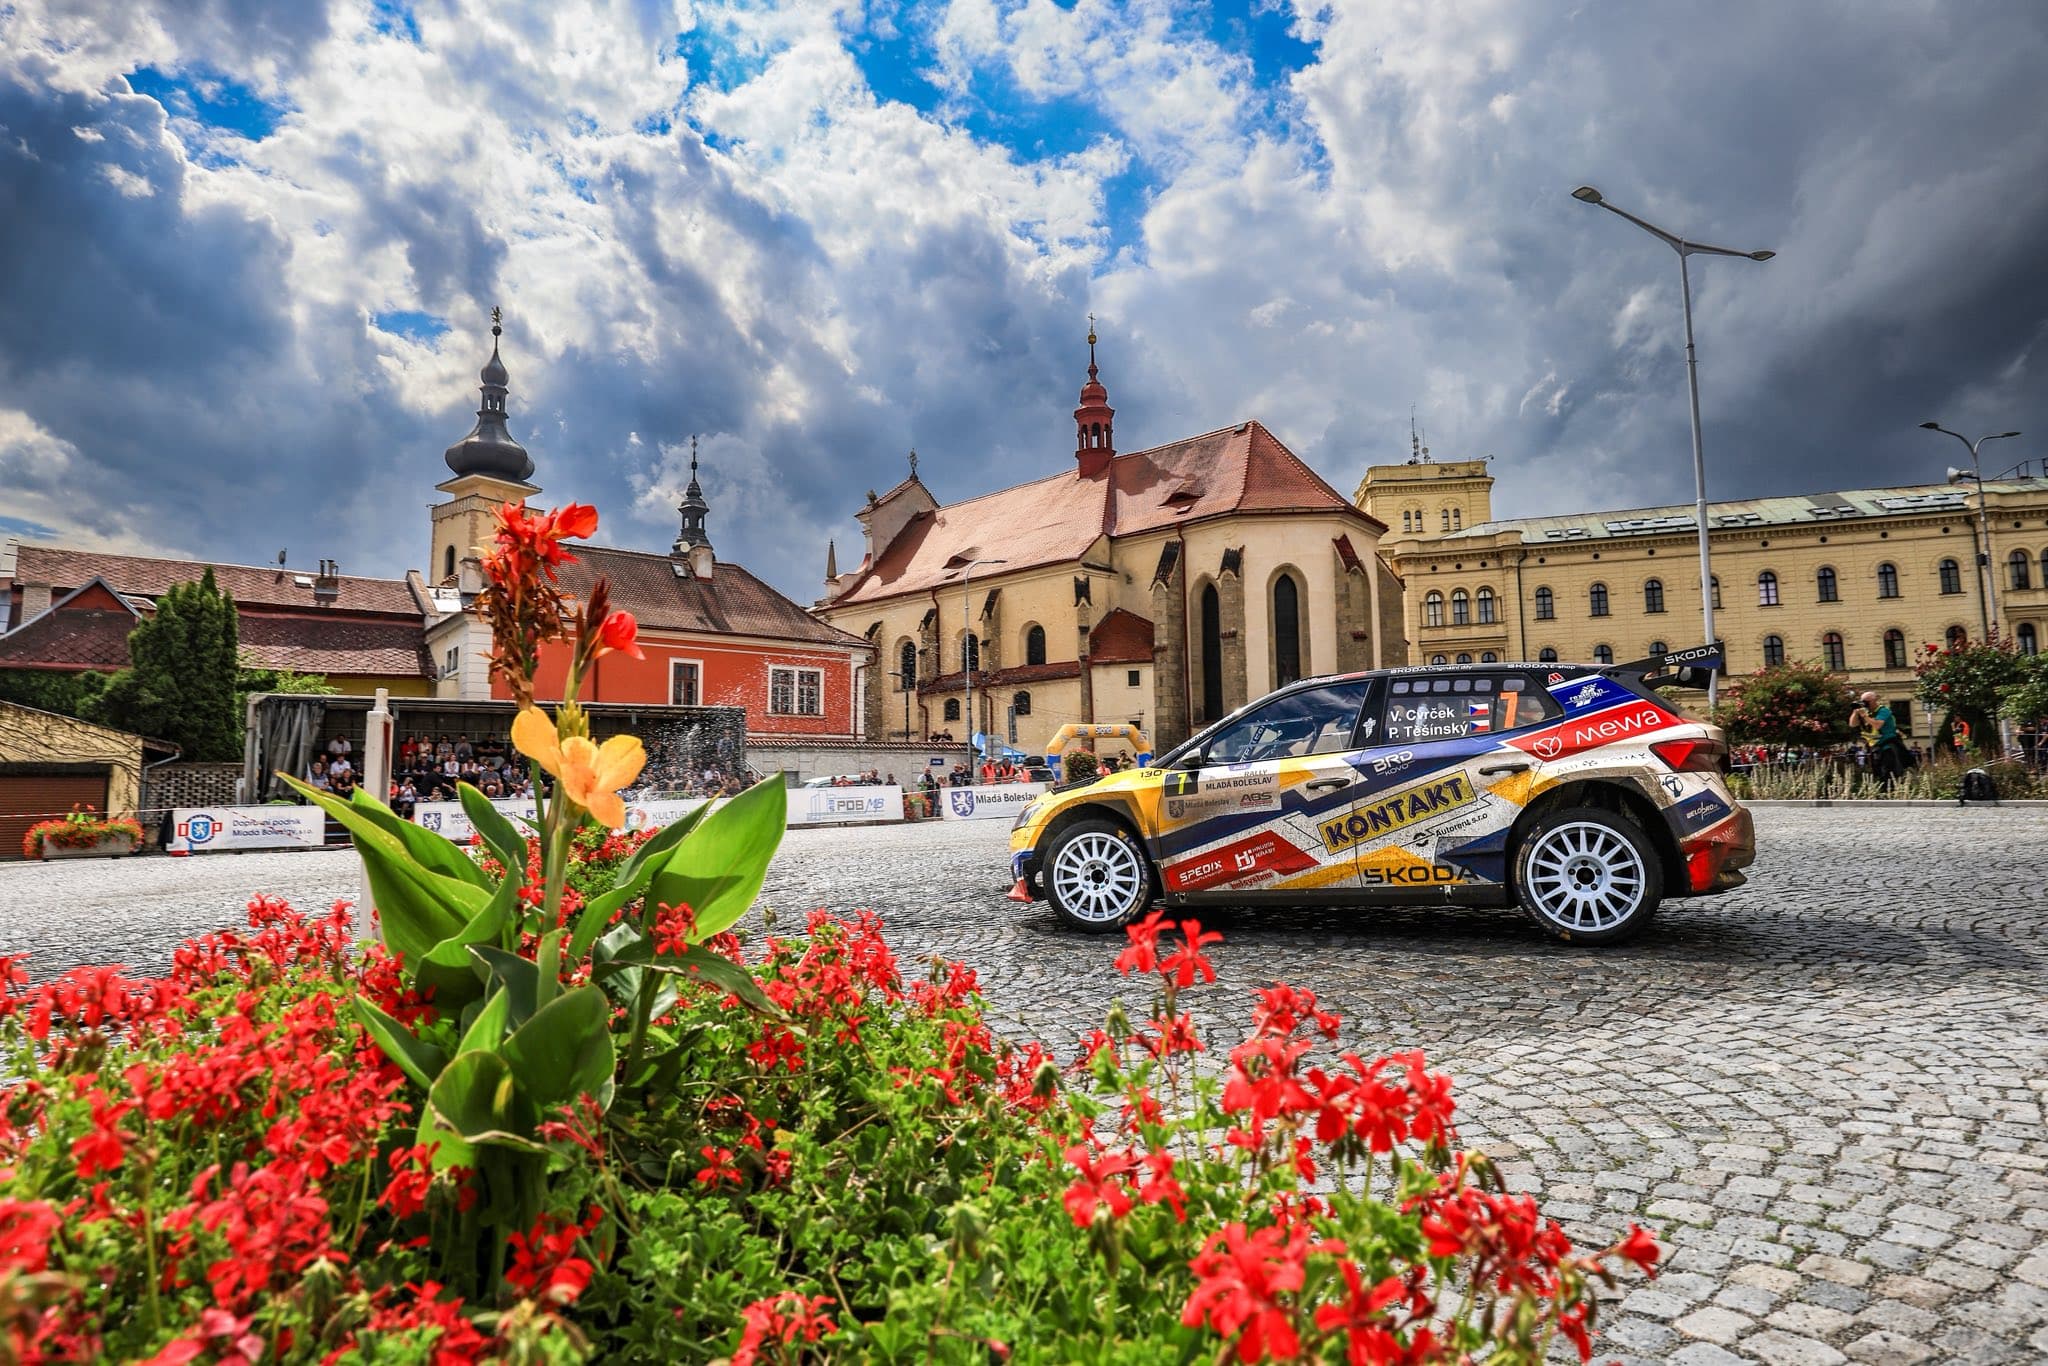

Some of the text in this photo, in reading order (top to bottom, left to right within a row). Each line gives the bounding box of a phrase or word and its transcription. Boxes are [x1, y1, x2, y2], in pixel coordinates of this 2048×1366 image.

[1390, 707, 1455, 722] V. Cvrček
[1500, 691, 1518, 729] 7
[1388, 721, 1469, 739] P. Těšínský
[1372, 750, 1414, 773] BRD
[1140, 769, 1163, 778] 130
[1243, 769, 1268, 778] RALLY
[1177, 772, 1188, 795] 7
[1233, 776, 1273, 788] BOLESLAV
[1004, 792, 1038, 802] Boleslav
[1240, 791, 1273, 802] ABS
[1325, 777, 1463, 847] KONTAKT
[232, 819, 271, 828] Doprní
[1179, 860, 1223, 882] SPEDIX
